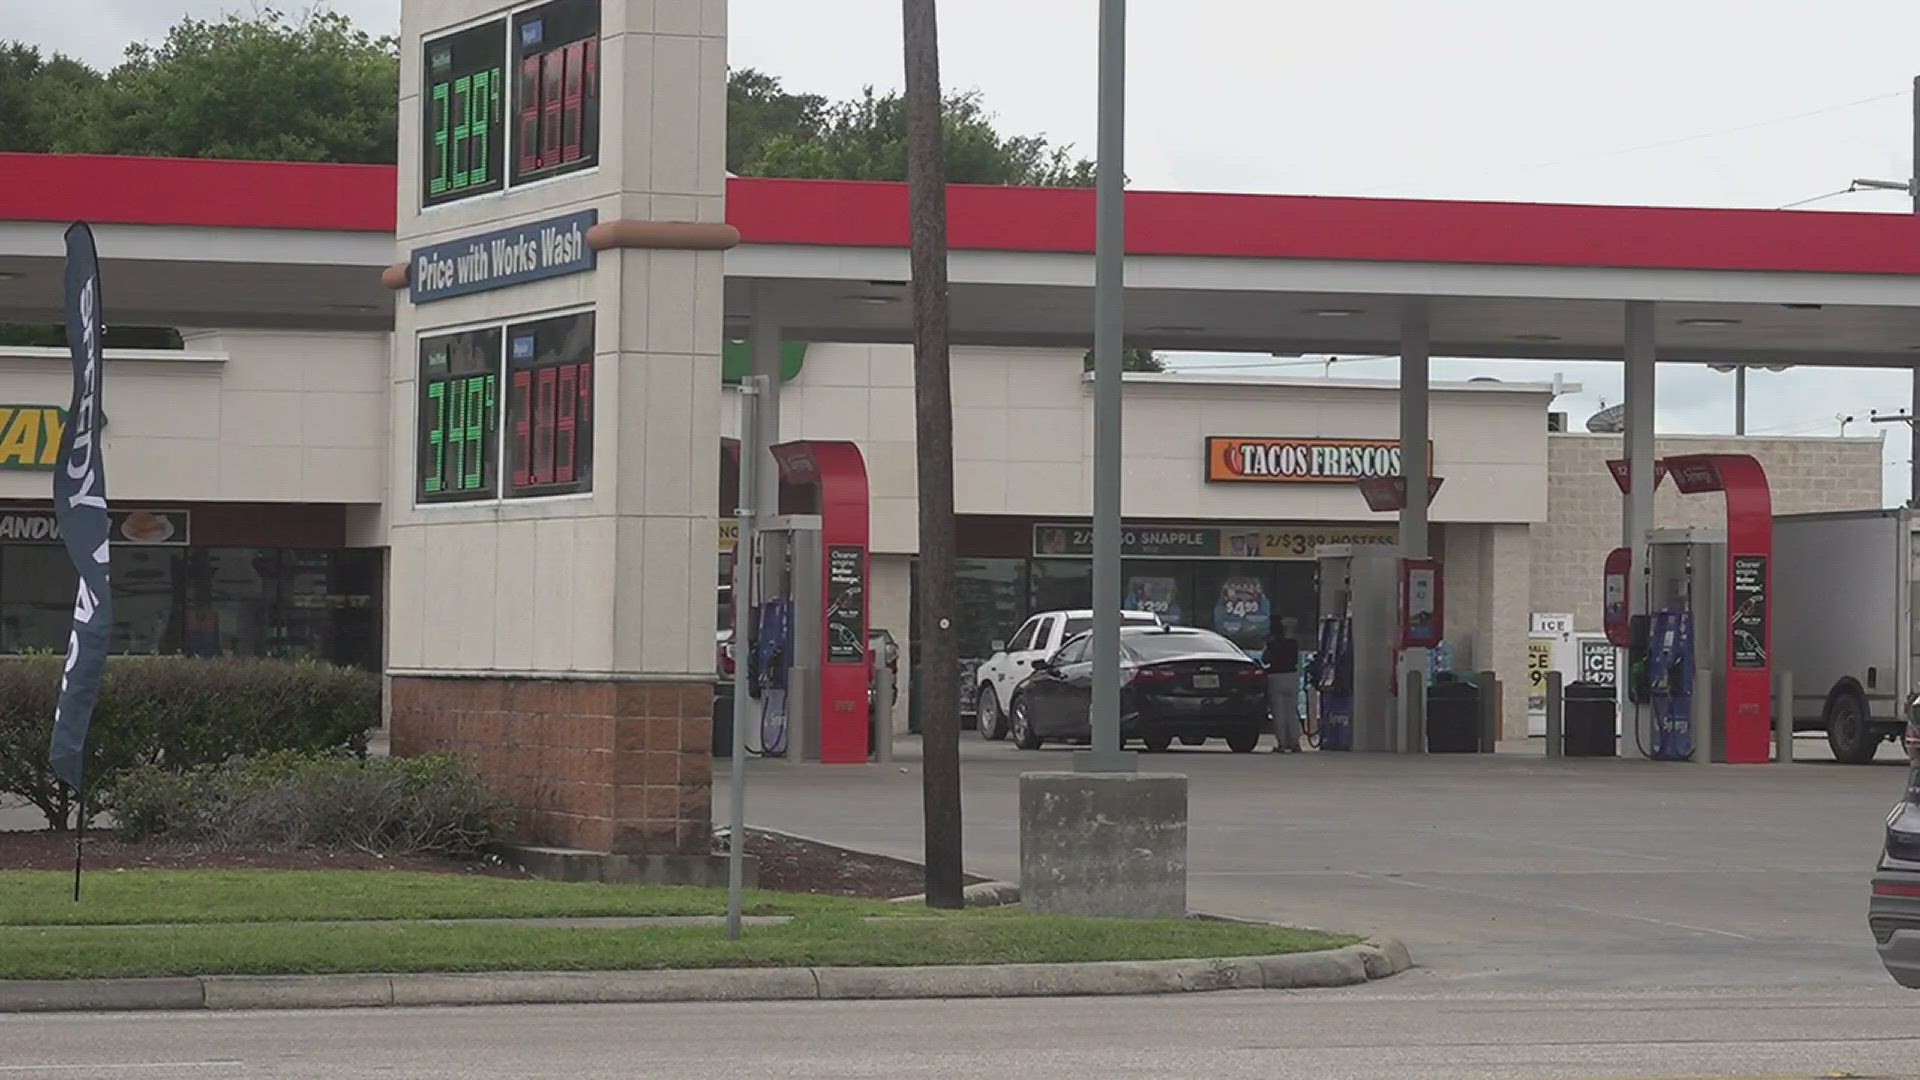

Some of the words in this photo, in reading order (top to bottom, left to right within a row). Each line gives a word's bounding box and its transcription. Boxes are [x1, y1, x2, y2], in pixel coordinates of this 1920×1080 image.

[418, 252, 454, 292] Price
[457, 242, 488, 284] with
[491, 234, 537, 277] Works
[540, 222, 582, 267] Wash
[1240, 444, 1307, 476] TACOS
[1310, 446, 1401, 477] FRESCOS
[1141, 532, 1204, 545] SNAPPLE
[1541, 621, 1565, 631] ICE
[1585, 646, 1614, 655] LARGE
[1585, 655, 1614, 670] ICE
